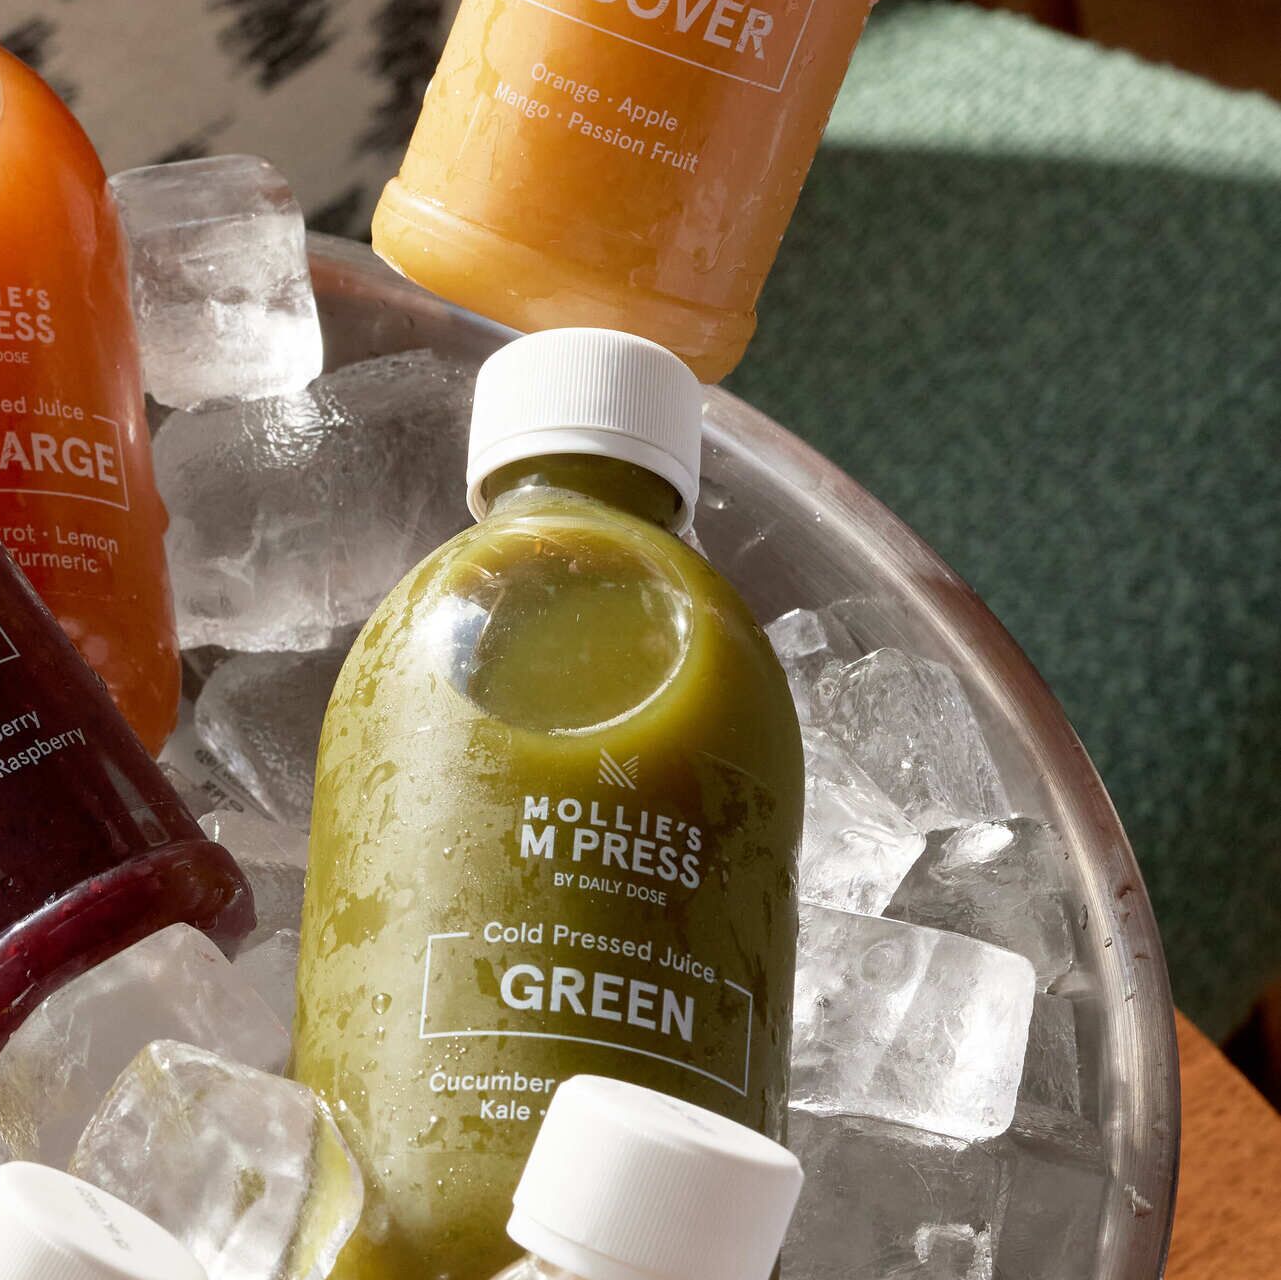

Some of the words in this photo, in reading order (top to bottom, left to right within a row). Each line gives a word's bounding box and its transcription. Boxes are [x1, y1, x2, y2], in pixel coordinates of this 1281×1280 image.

[530, 62, 600, 104] Orange
[618, 94, 678, 132] Apple
[494, 80, 550, 121] Mango
[568, 111, 645, 155] Passion
[651, 139, 699, 174] Fruit
[33, 398, 84, 420] Juice
[7, 548, 98, 574] Turmeric
[56, 526, 118, 554] Lemon
[523, 795, 703, 853] MOLLIE'S
[520, 825, 556, 859] M
[573, 827, 701, 890] PRESS
[553, 873, 575, 887] BY
[578, 876, 623, 895] DAILY
[627, 883, 667, 906] DOSE
[483, 920, 543, 946] Cold
[553, 925, 653, 963] Pressed
[659, 945, 716, 985] Juice
[500, 963, 694, 1044] GREEN
[429, 1071, 555, 1094] Cucumber
[480, 1099, 531, 1121] Kale
